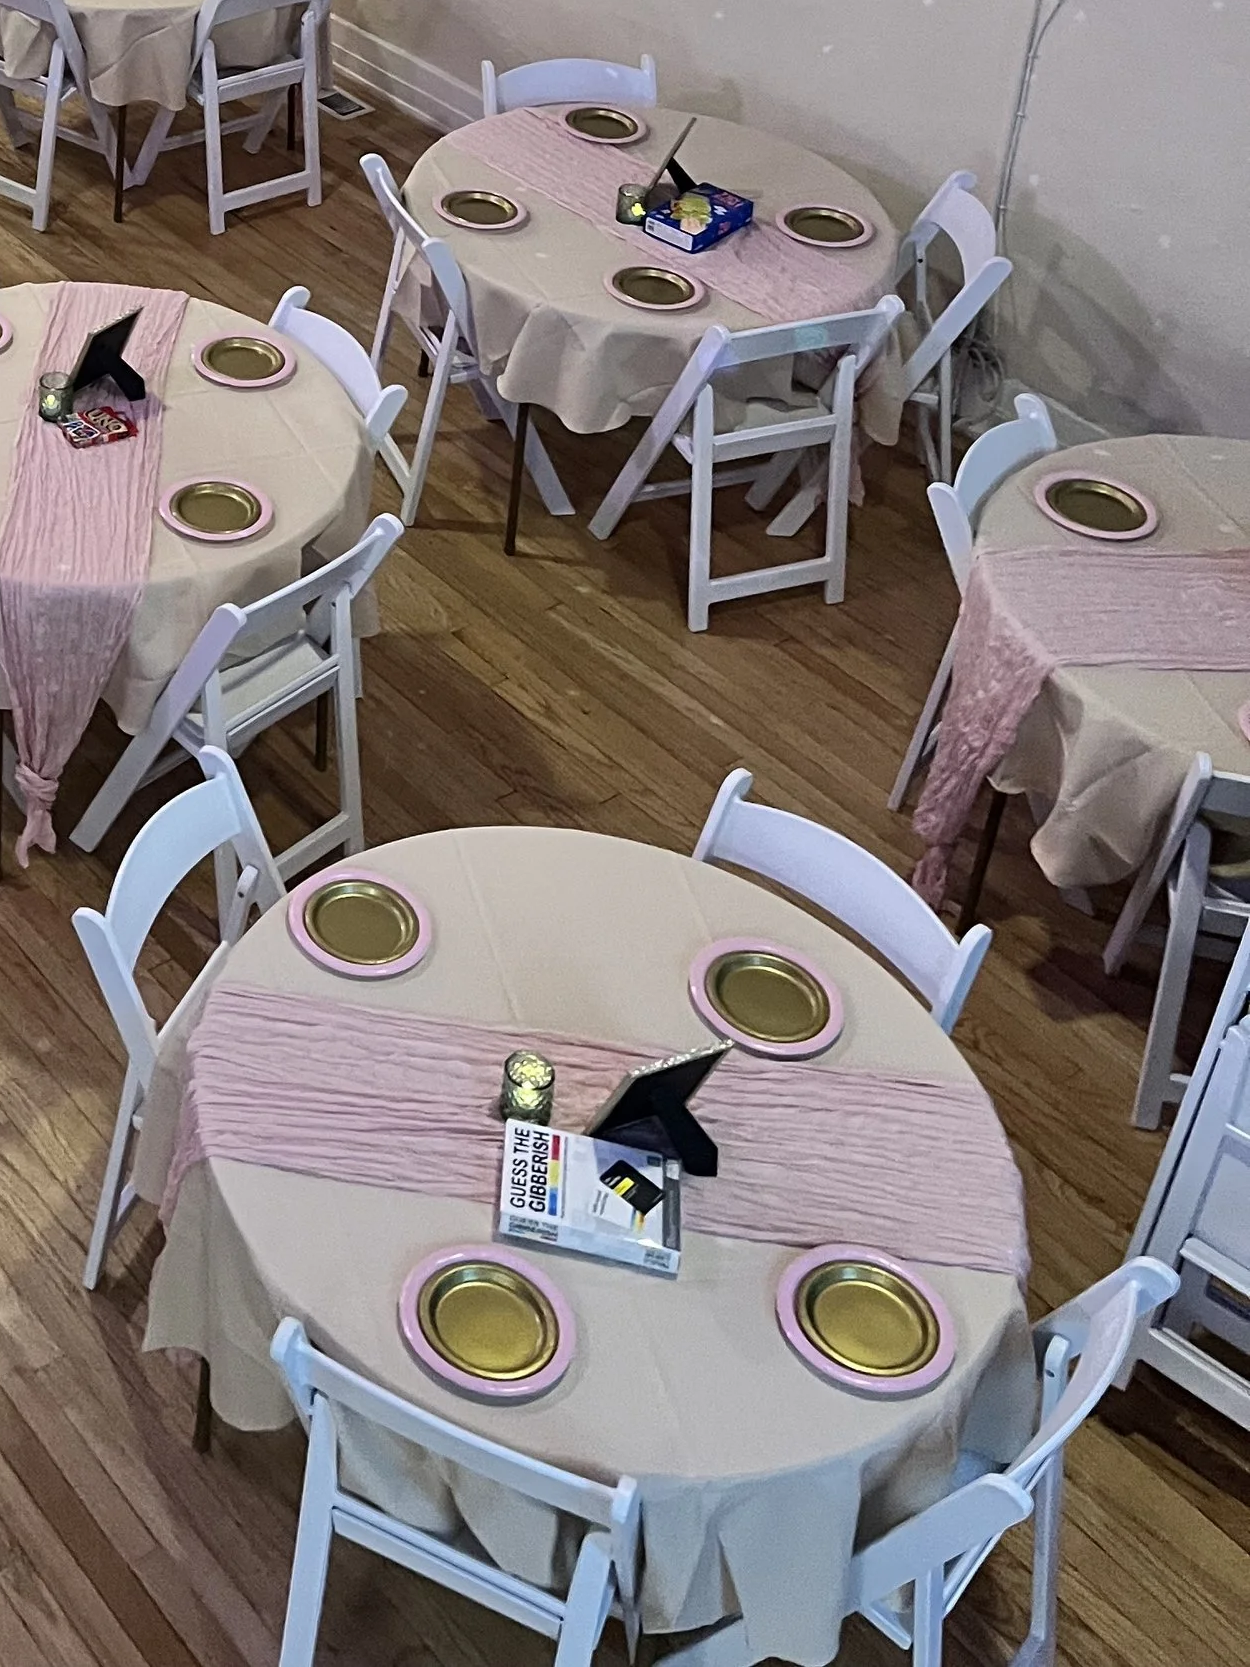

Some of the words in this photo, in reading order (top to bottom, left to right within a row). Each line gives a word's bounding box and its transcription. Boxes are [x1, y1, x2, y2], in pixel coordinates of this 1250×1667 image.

[86, 408, 123, 432] UNO
[513, 1127, 530, 1154] THE
[510, 1158, 528, 1209] GUESS
[528, 1130, 550, 1213] GIBBERISH
